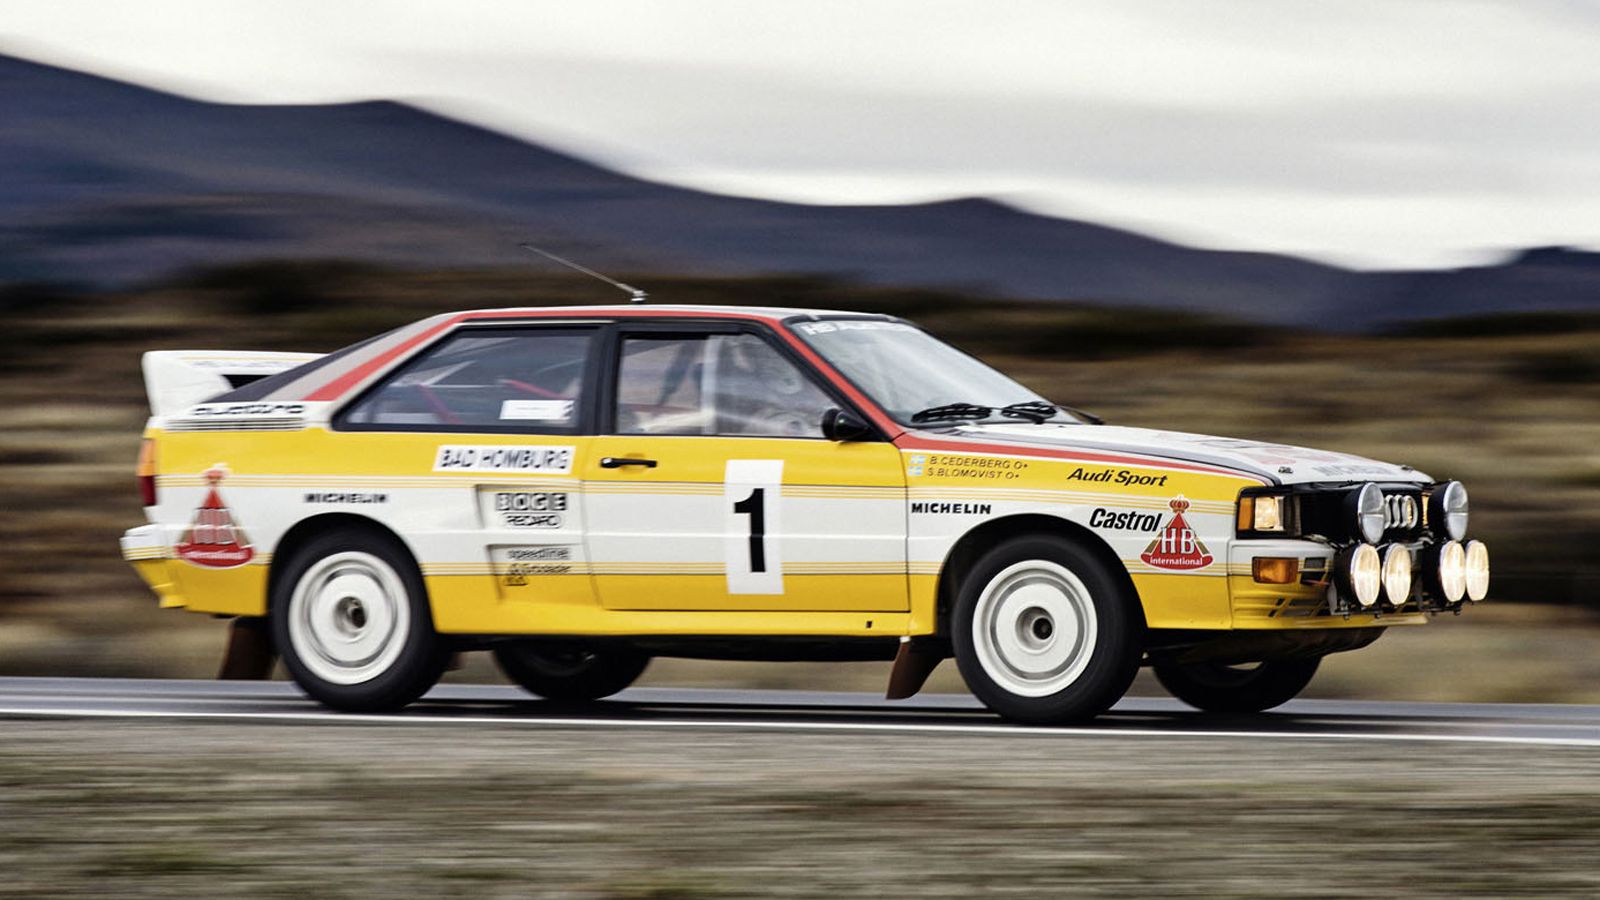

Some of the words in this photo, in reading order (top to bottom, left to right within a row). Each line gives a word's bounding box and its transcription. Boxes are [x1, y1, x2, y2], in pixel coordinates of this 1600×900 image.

[441, 449, 475, 468] BAD
[478, 449, 569, 470] HOMBURG
[1067, 468, 1114, 482] Audi
[1114, 470, 1168, 487] Sport
[303, 493, 388, 504] MICHELIN
[495, 492, 568, 511] BOGE
[911, 502, 992, 515] MICHELIN
[1089, 507, 1163, 532] Castrol
[733, 487, 766, 573] 1
[1160, 527, 1196, 555] HB
[1150, 556, 1203, 566] international
